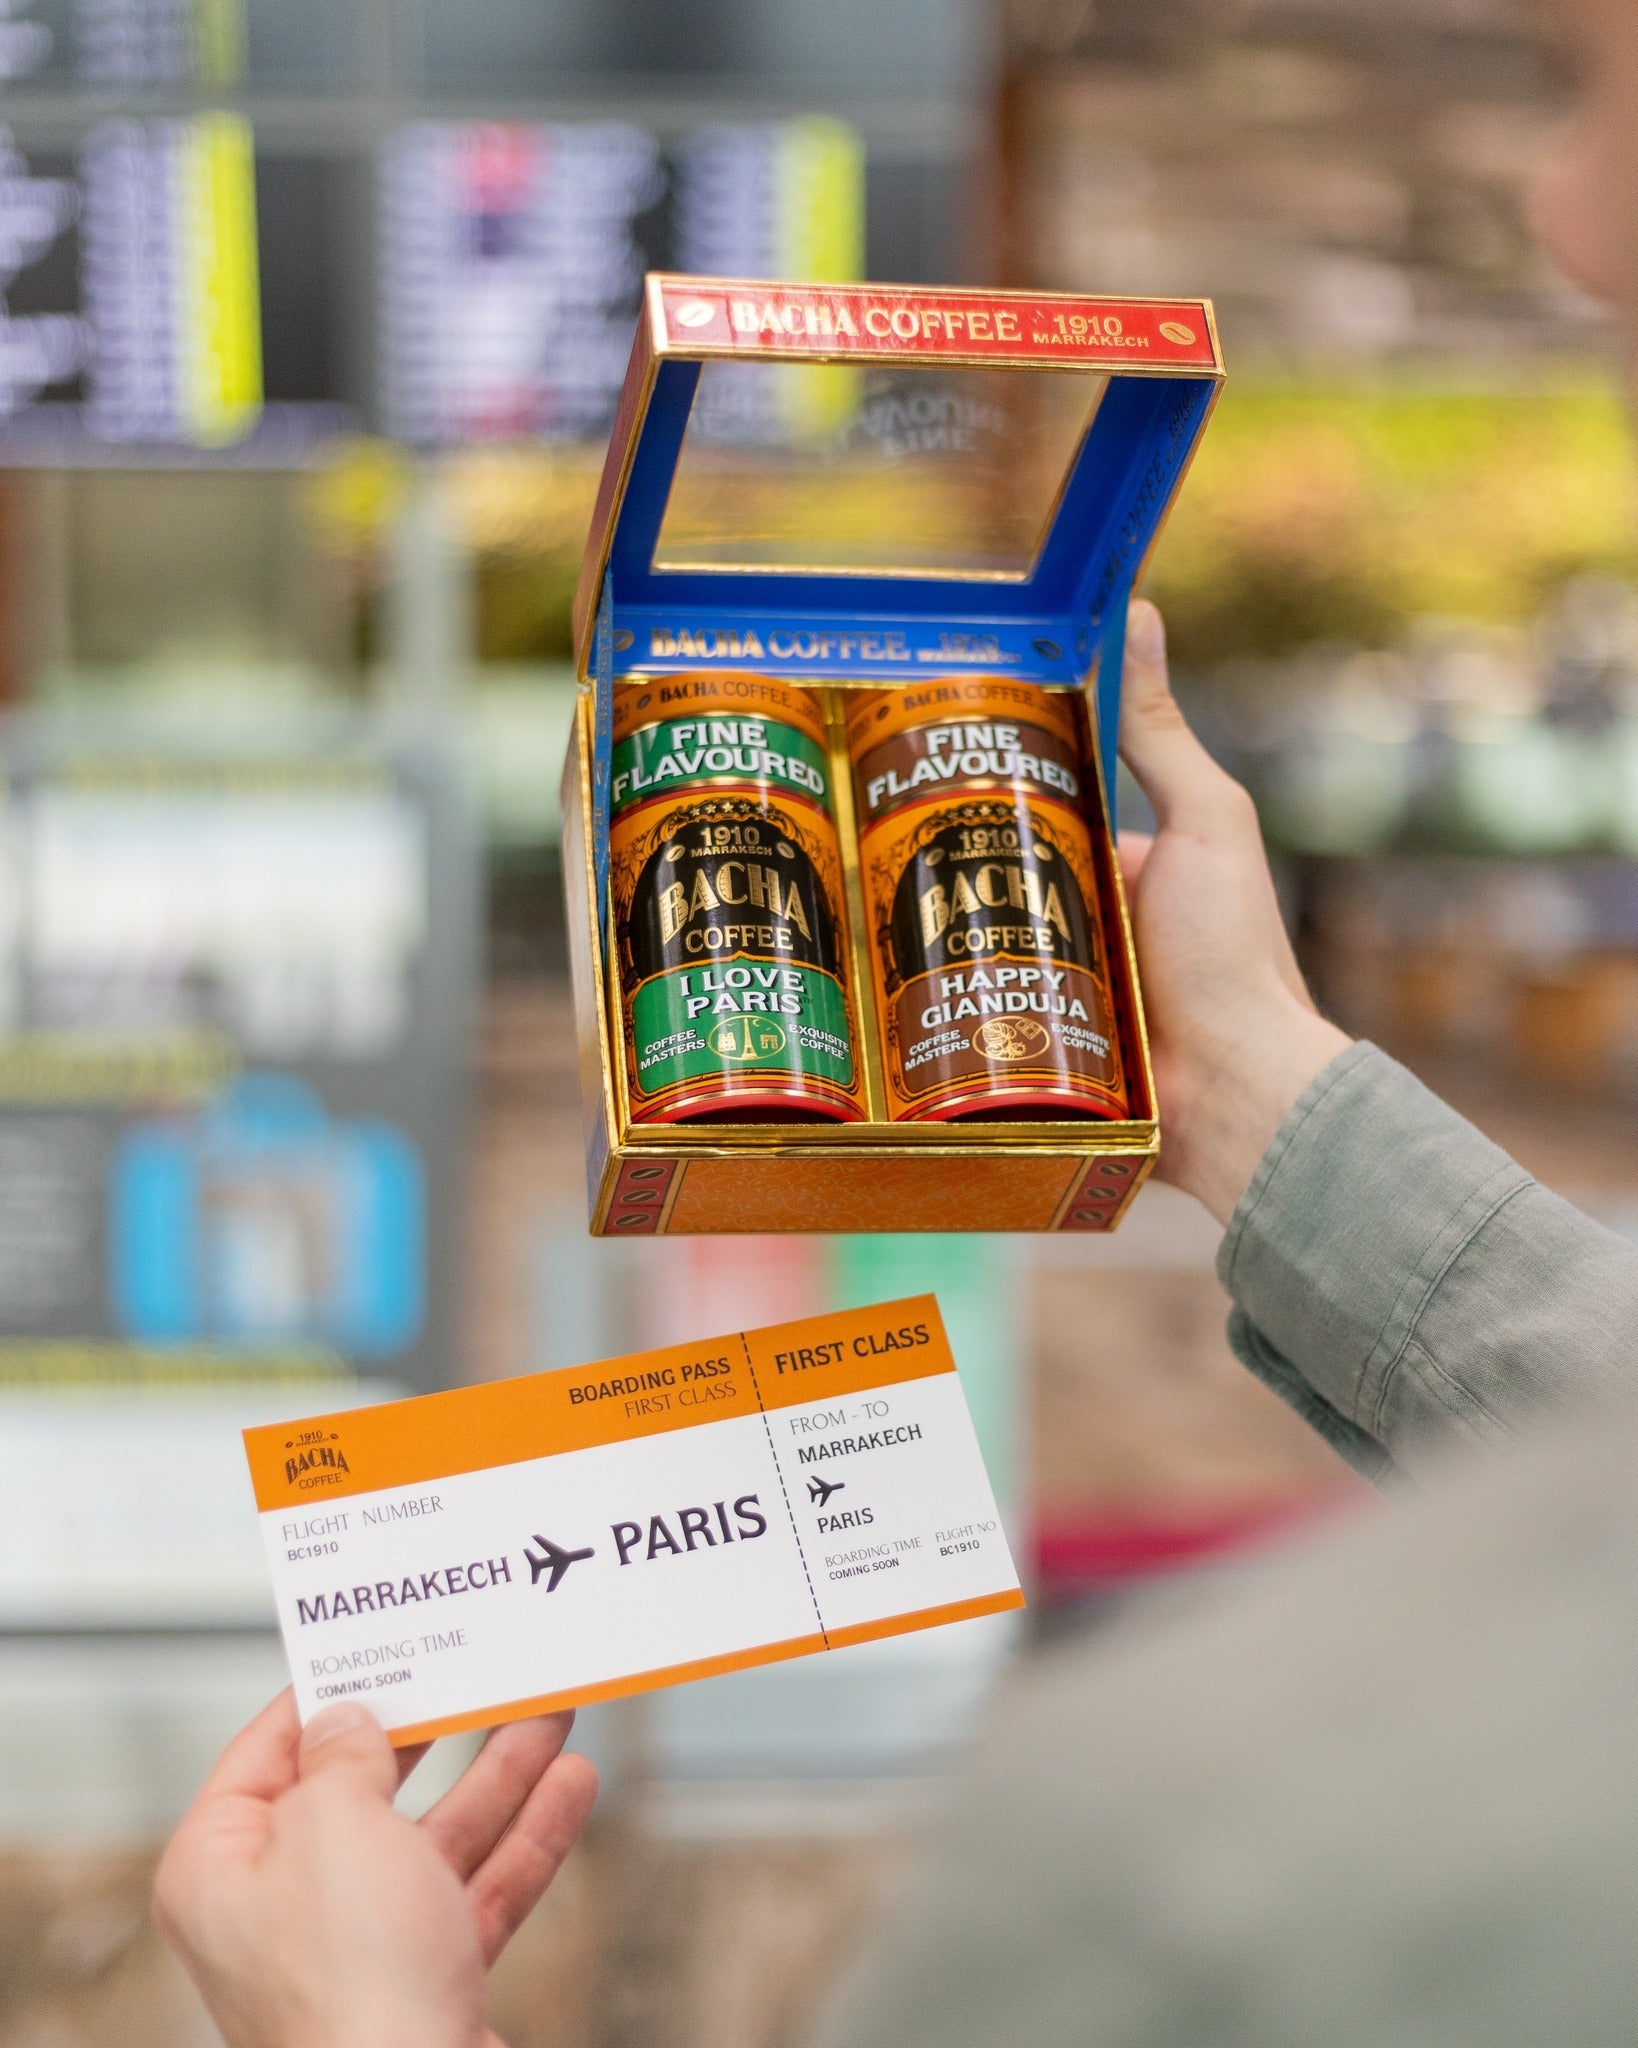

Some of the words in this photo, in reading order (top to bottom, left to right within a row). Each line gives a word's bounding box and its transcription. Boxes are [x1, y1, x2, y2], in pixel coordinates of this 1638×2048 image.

[731, 301, 860, 337] BACHA
[865, 308, 1022, 342] COFFEE
[1053, 314, 1123, 337] 1910
[1033, 333, 1149, 348] MARRAKECH
[651, 627, 765, 658] BACHA
[769, 630, 911, 660] COFFEE
[660, 680, 719, 703] BACHA
[723, 681, 792, 708] COFFEE
[670, 721, 767, 751] FINE
[925, 724, 1022, 755] FINE
[613, 748, 825, 804] FLAVOURED
[866, 751, 1079, 809] FLAVOURED
[701, 826, 760, 846] 1910
[959, 829, 1018, 850] 1910
[691, 845, 773, 858] MARRAKECH
[659, 861, 812, 945] BACHA
[920, 864, 1072, 948] BACHA
[685, 925, 794, 953] COFFEE
[947, 926, 1055, 955] COFFEE
[679, 975, 690, 997] I
[702, 967, 805, 993] LOVE
[940, 967, 1066, 998] HAPPY
[686, 991, 802, 1020] PARIS
[921, 991, 1089, 1029] GIANDUJA
[645, 1028, 697, 1056] COFFEE
[789, 1023, 849, 1053] EXQUISITE
[800, 1038, 845, 1061] COFFEE
[909, 1029, 961, 1056] COFFEE
[1051, 1022, 1110, 1051] EXQUISITE
[1062, 1036, 1107, 1060] COFFEE
[640, 1038, 706, 1071] MASTERS
[904, 1038, 971, 1072] MASTERS
[774, 1341, 845, 1375] FIRST
[852, 1323, 931, 1358] CLASS
[568, 1368, 676, 1405] BOARDING
[682, 1357, 732, 1383] PASS
[624, 1393, 672, 1418] FIRST
[678, 1380, 737, 1407] CLASS
[790, 1409, 847, 1436] FROM
[862, 1400, 889, 1420] TO
[299, 1430, 323, 1442] 1910
[797, 1423, 923, 1464] MARRAKECH
[284, 1447, 351, 1485] BACHA
[298, 1472, 343, 1490] COFFEE
[282, 1513, 350, 1542] FLIGHT
[362, 1495, 444, 1527] NUMBER
[817, 1507, 874, 1534] PARIS
[935, 1525, 974, 1543] FLIGHT
[977, 1520, 997, 1534] NO
[287, 1541, 339, 1561] BC1910
[296, 1555, 513, 1625] MARRAKECH
[610, 1494, 769, 1566] PARIS
[825, 1544, 890, 1568] BOARDING
[893, 1537, 923, 1553] TIME
[940, 1539, 981, 1557] BC1910
[829, 1564, 871, 1581] COMING
[872, 1557, 900, 1572] SOON
[310, 1638, 416, 1677] BOARDING
[420, 1628, 469, 1654] TIME
[316, 1675, 372, 1700] COMING
[375, 1668, 413, 1690] SOON
